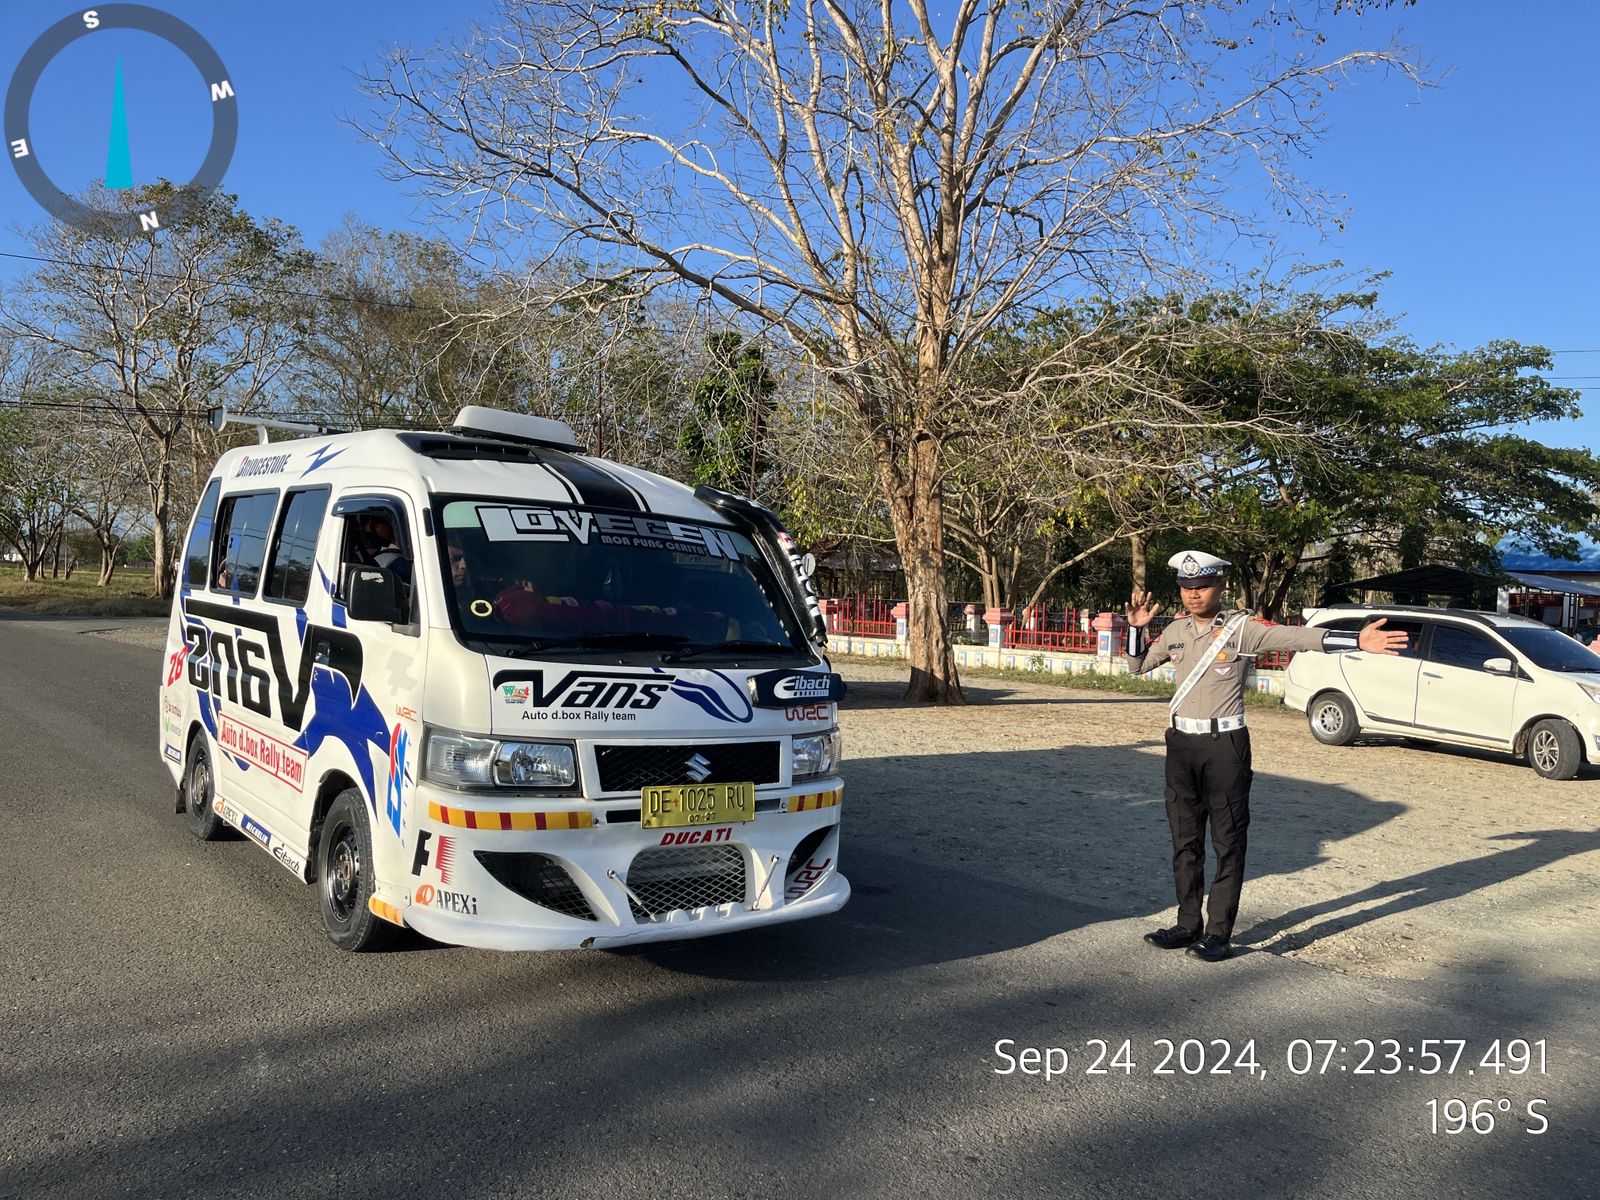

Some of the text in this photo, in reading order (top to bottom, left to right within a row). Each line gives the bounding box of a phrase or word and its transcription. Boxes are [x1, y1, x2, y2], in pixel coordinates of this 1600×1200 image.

[493, 670, 675, 709] Vans
[773, 675, 830, 699] Eibach
[522, 710, 636, 723] Auto d.box Rally team
[221, 720, 303, 784] Auto d.box Rally team
[649, 789, 671, 813] DE
[679, 786, 716, 812] 1025
[659, 827, 733, 846] DUCATI
